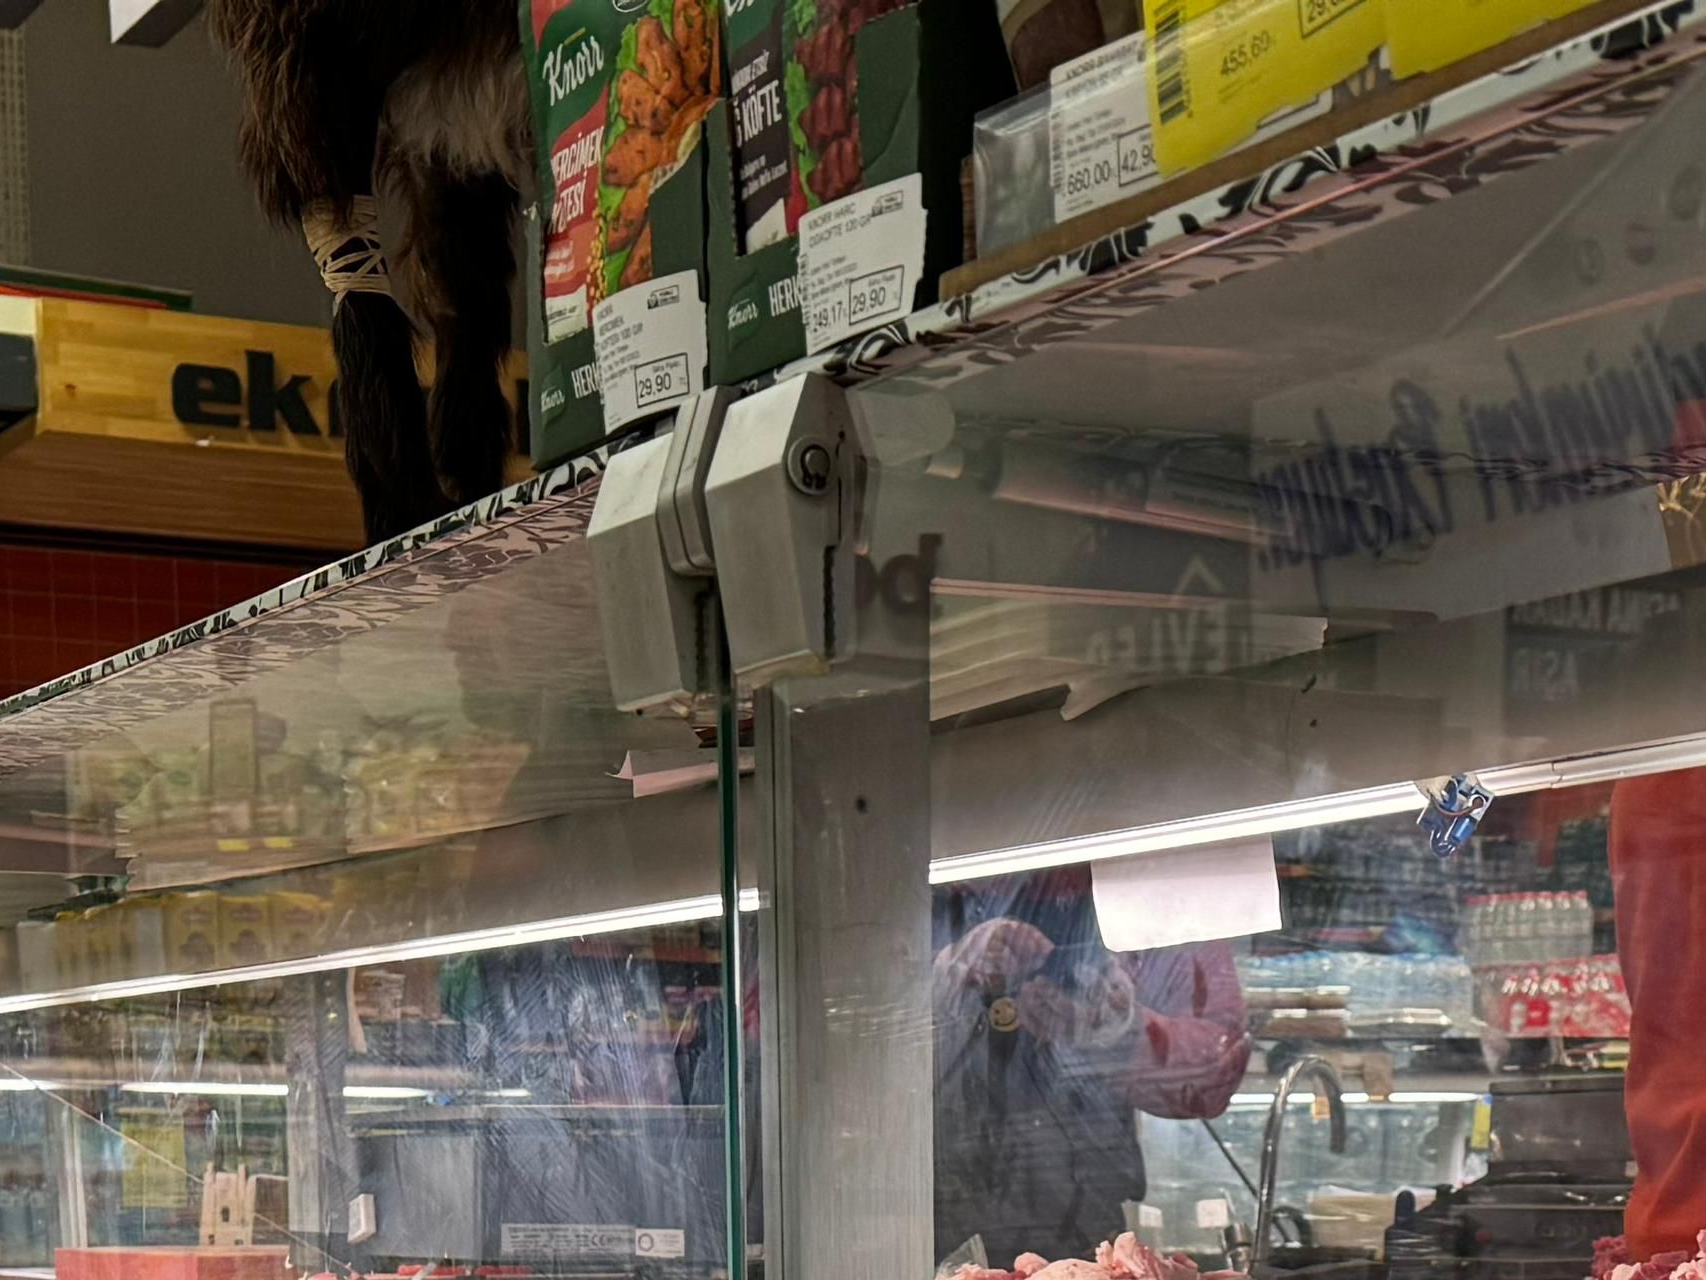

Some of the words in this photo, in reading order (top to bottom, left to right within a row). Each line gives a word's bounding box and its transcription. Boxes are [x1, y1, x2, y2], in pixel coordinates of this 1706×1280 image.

[542, 36, 605, 106] Knorr
[743, 80, 782, 142] KÖFTE
[852, 286, 886, 315] 29,90
[638, 372, 672, 399] 29,90
